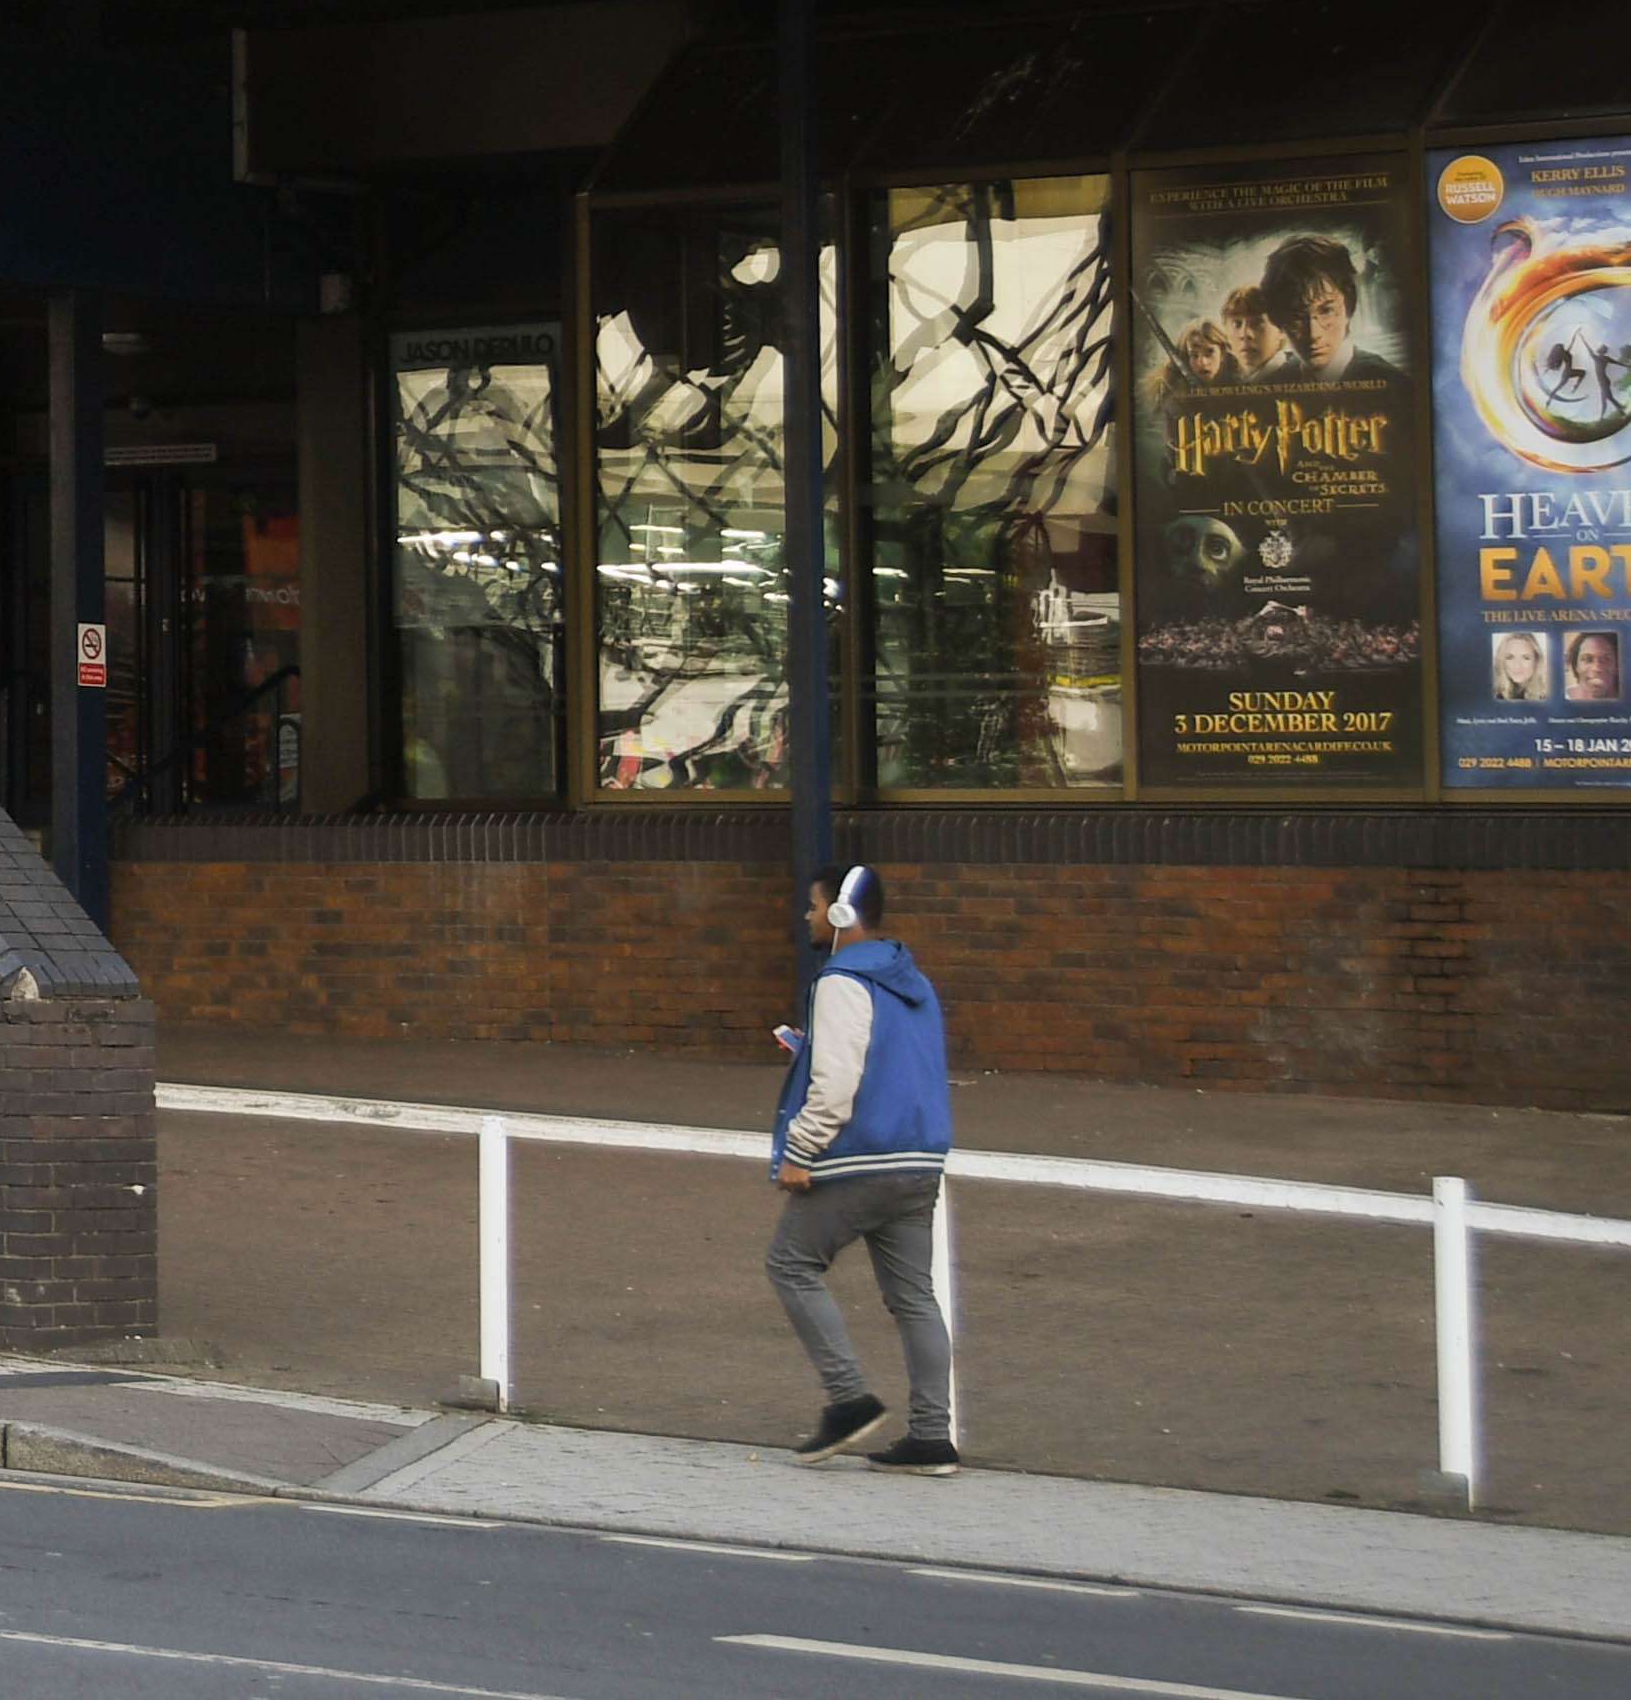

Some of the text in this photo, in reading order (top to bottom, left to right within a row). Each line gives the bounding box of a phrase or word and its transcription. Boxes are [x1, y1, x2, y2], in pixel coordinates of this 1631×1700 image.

[1531, 165, 1626, 183] KERRY ELLIS
[1261, 182, 1300, 195] MAGIC
[1355, 176, 1388, 189] FILM
[1445, 182, 1496, 194] RUSSELL
[1445, 193, 1497, 205] WATSON
[401, 339, 470, 363] JASON
[1166, 399, 1388, 477] Harry Potter
[1292, 470, 1379, 484] CHAMBER
[1320, 483, 1387, 496] SECRETS
[1223, 498, 1335, 517] IN CONCERT
[1576, 529, 1599, 541] ON
[1482, 610, 1512, 623] THE
[1514, 609, 1546, 622] LIVE
[1551, 608, 1597, 621] ARENA
[1228, 691, 1336, 712] SUNDAY
[1174, 711, 1394, 734] 3 DECEMBER 2017
[1535, 738, 1552, 753] 15
[1567, 738, 1585, 753] 18
[1586, 738, 1618, 753] JAN
[1248, 754, 1267, 765] 029
[1268, 754, 1291, 765] 2022
[1458, 757, 1477, 769] 029
[1479, 757, 1504, 768] 2022
